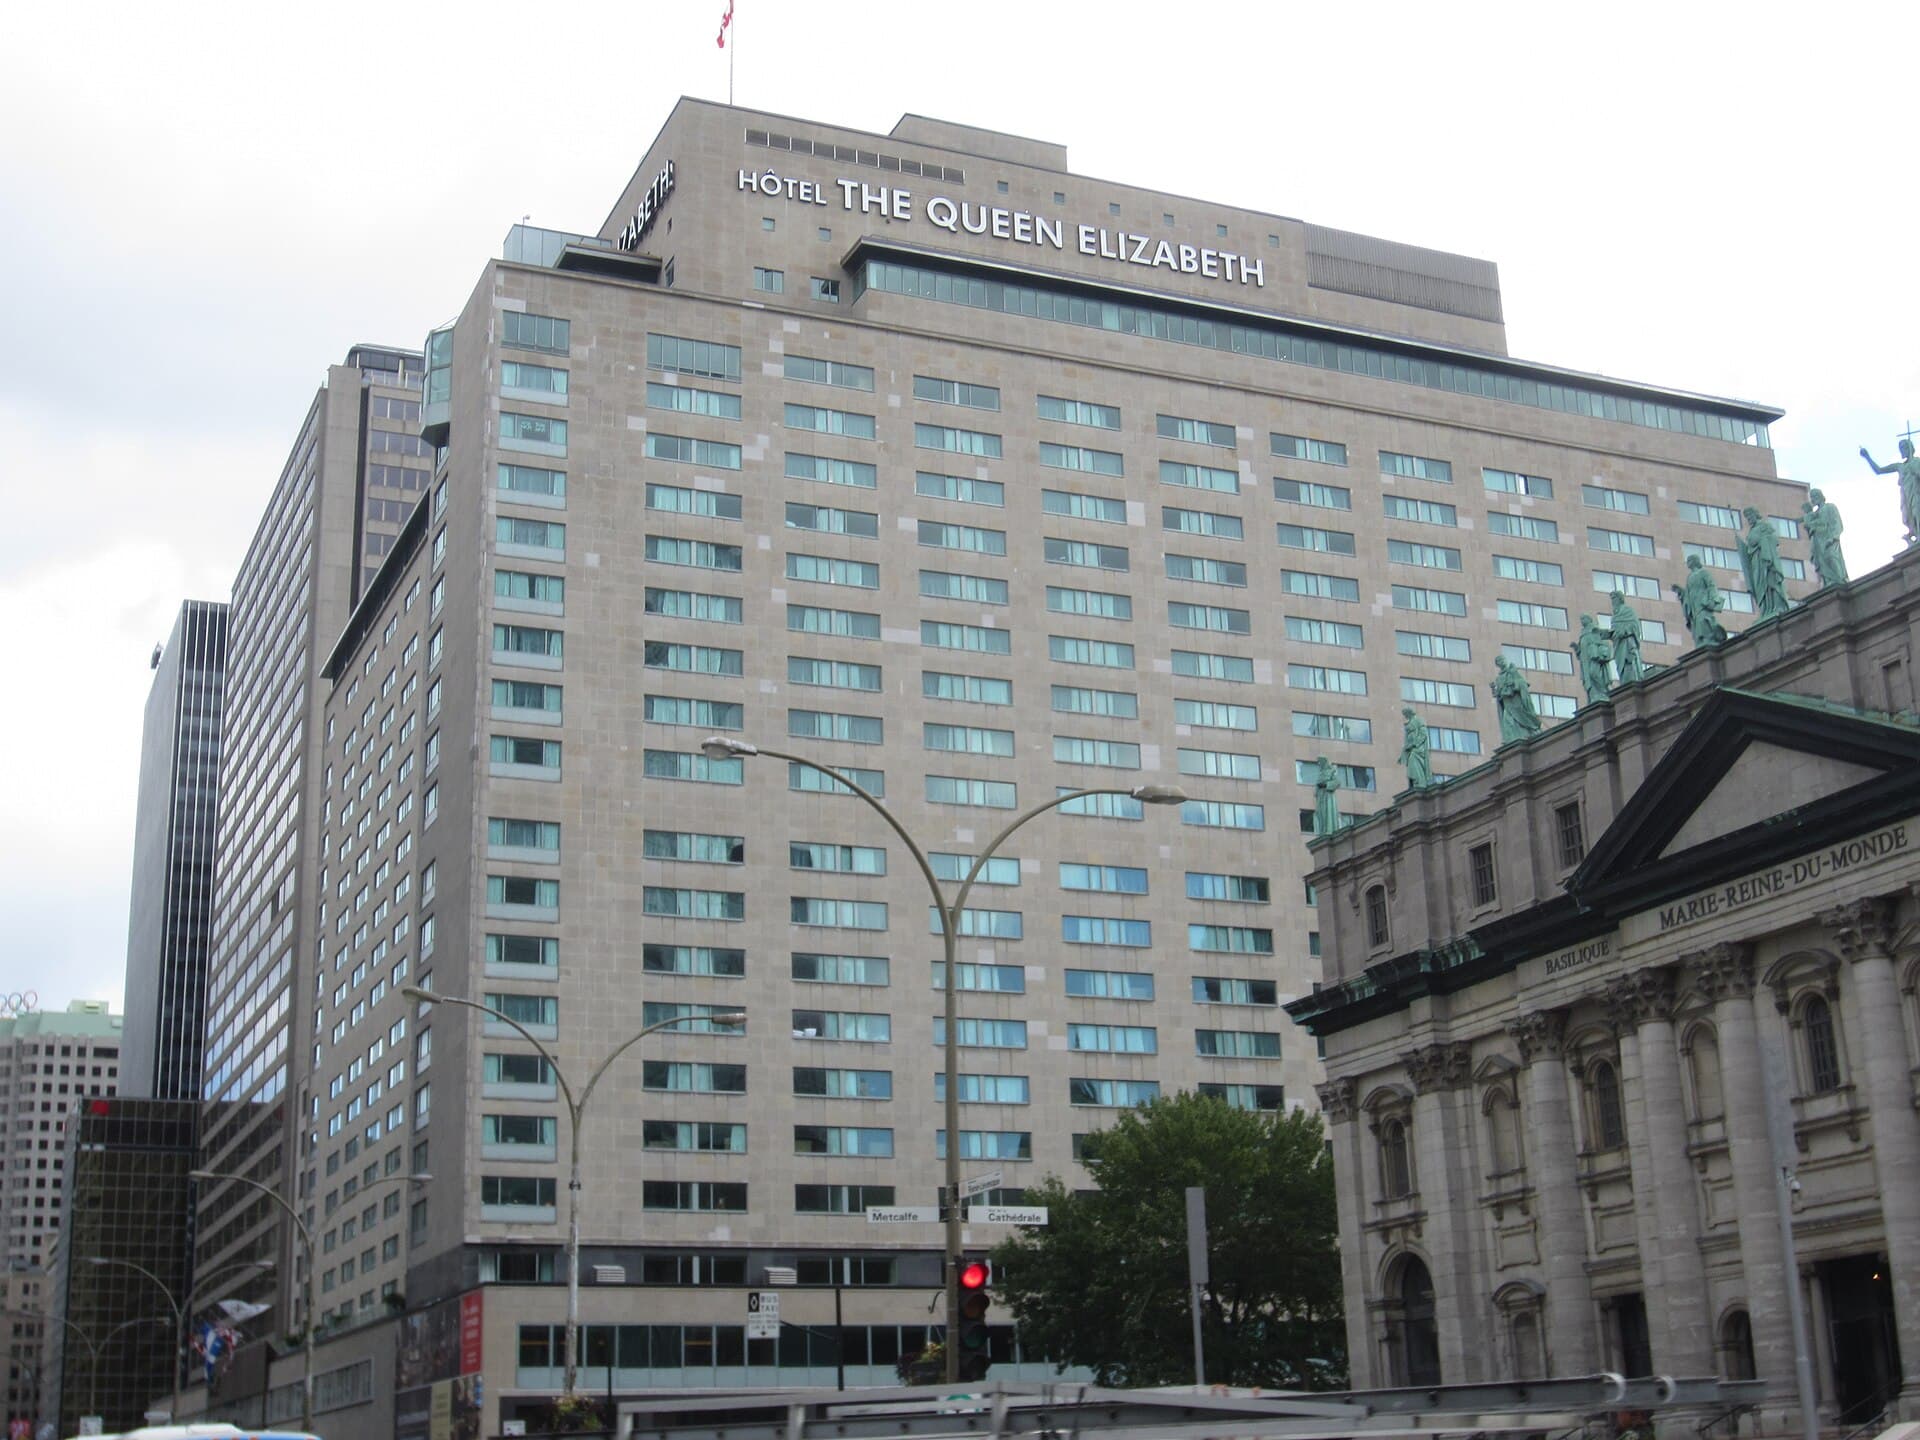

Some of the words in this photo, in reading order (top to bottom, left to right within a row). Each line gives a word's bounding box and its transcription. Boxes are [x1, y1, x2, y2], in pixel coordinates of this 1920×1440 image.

[738, 168, 827, 206] HÔTEL
[835, 178, 911, 221] THE
[925, 198, 1063, 250] QUEEN
[1077, 224, 1265, 288] ELIZABETH
[1545, 940, 1610, 976] BASILIQUE
[1659, 825, 1908, 932] MARIE-REINE-DU-MONDE
[872, 1212, 919, 1221] Metcalfe
